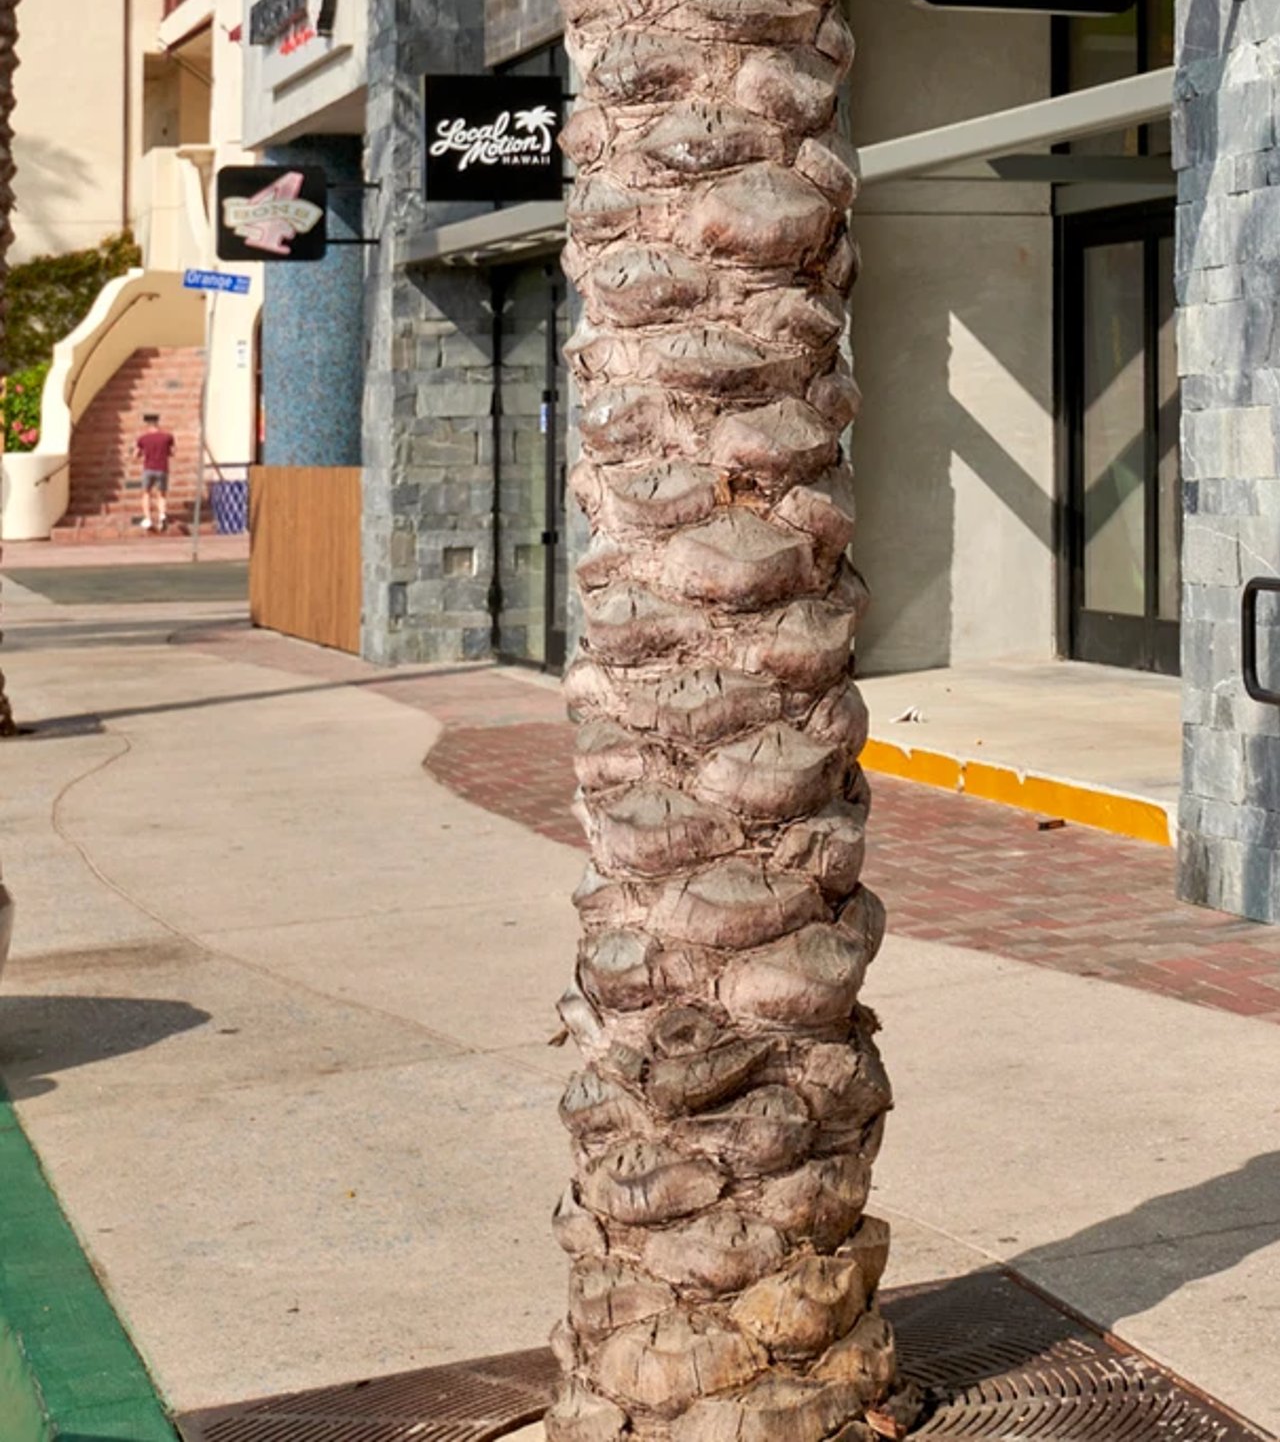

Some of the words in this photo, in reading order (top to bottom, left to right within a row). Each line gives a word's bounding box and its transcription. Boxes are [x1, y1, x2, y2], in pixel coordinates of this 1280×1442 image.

[429, 111, 511, 157] Local
[457, 134, 542, 172] Motion
[501, 155, 552, 166] HAWAII
